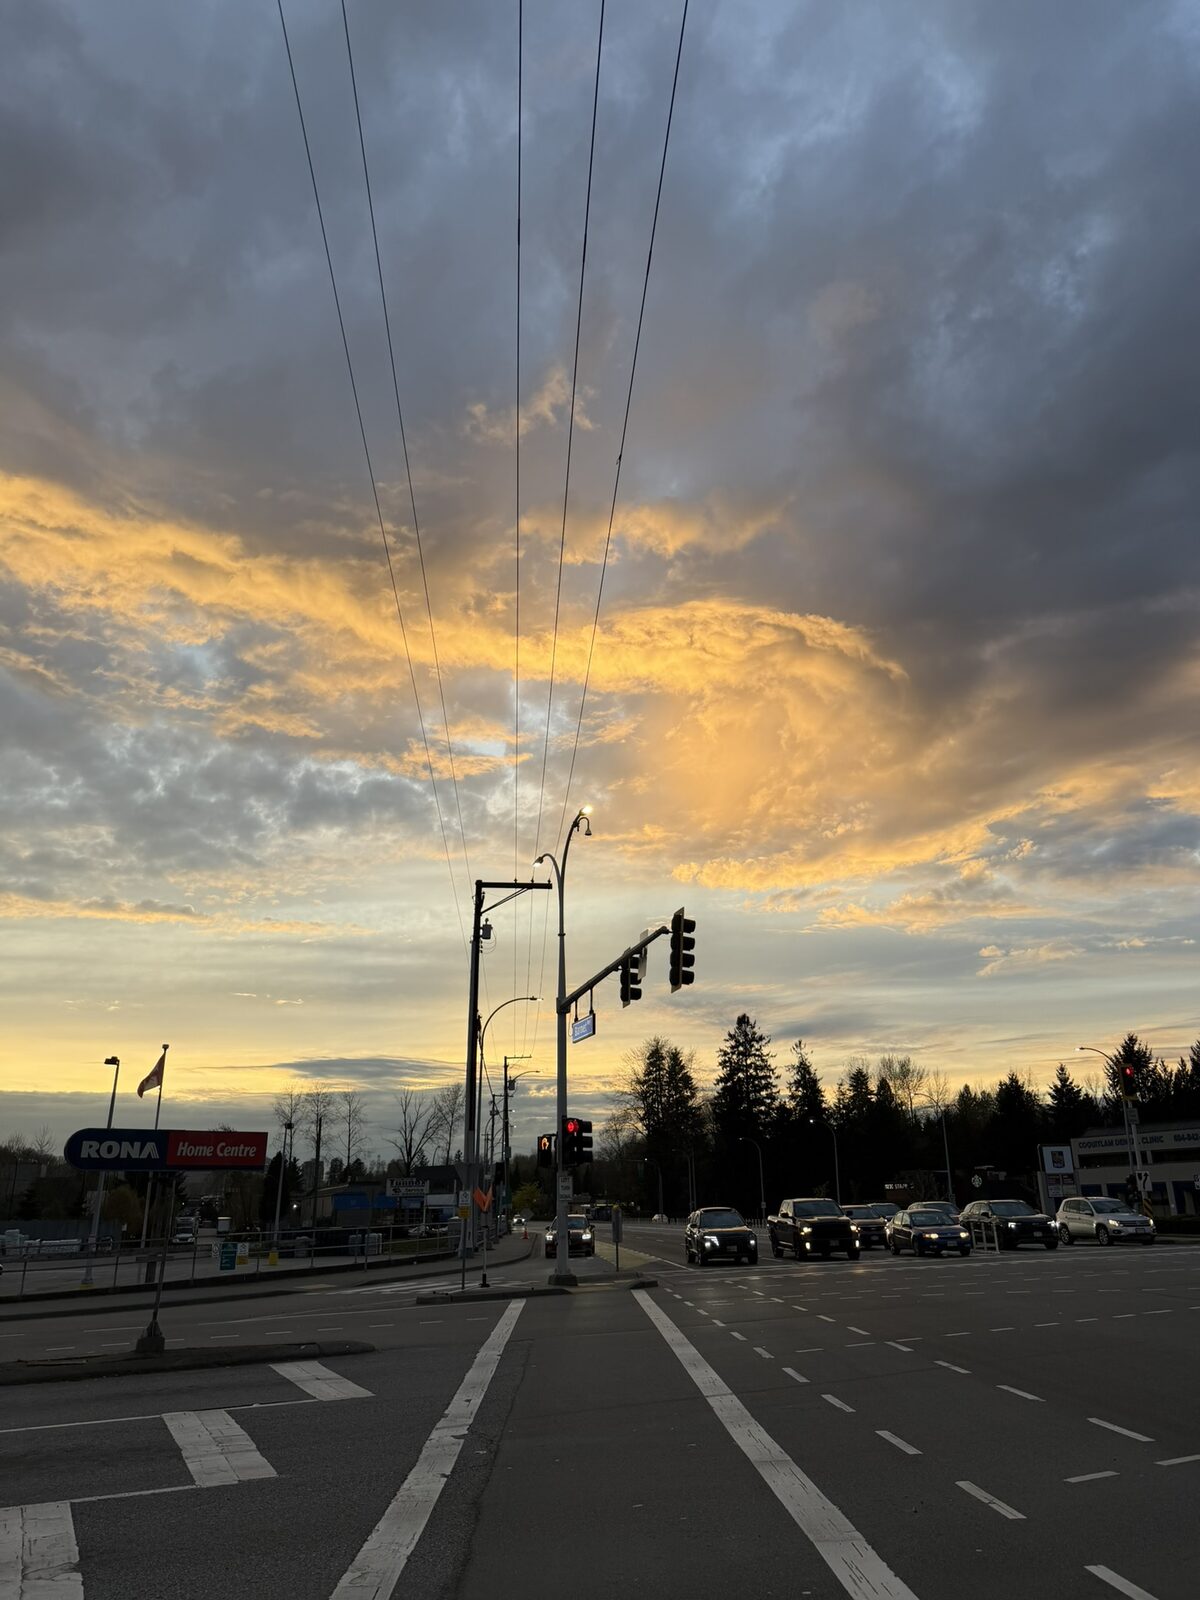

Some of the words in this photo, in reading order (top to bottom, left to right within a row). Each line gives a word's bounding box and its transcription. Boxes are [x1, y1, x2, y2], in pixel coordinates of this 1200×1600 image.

[79, 1140, 160, 1160] RONA
[176, 1142, 214, 1157] Home
[216, 1142, 257, 1158] Centre
